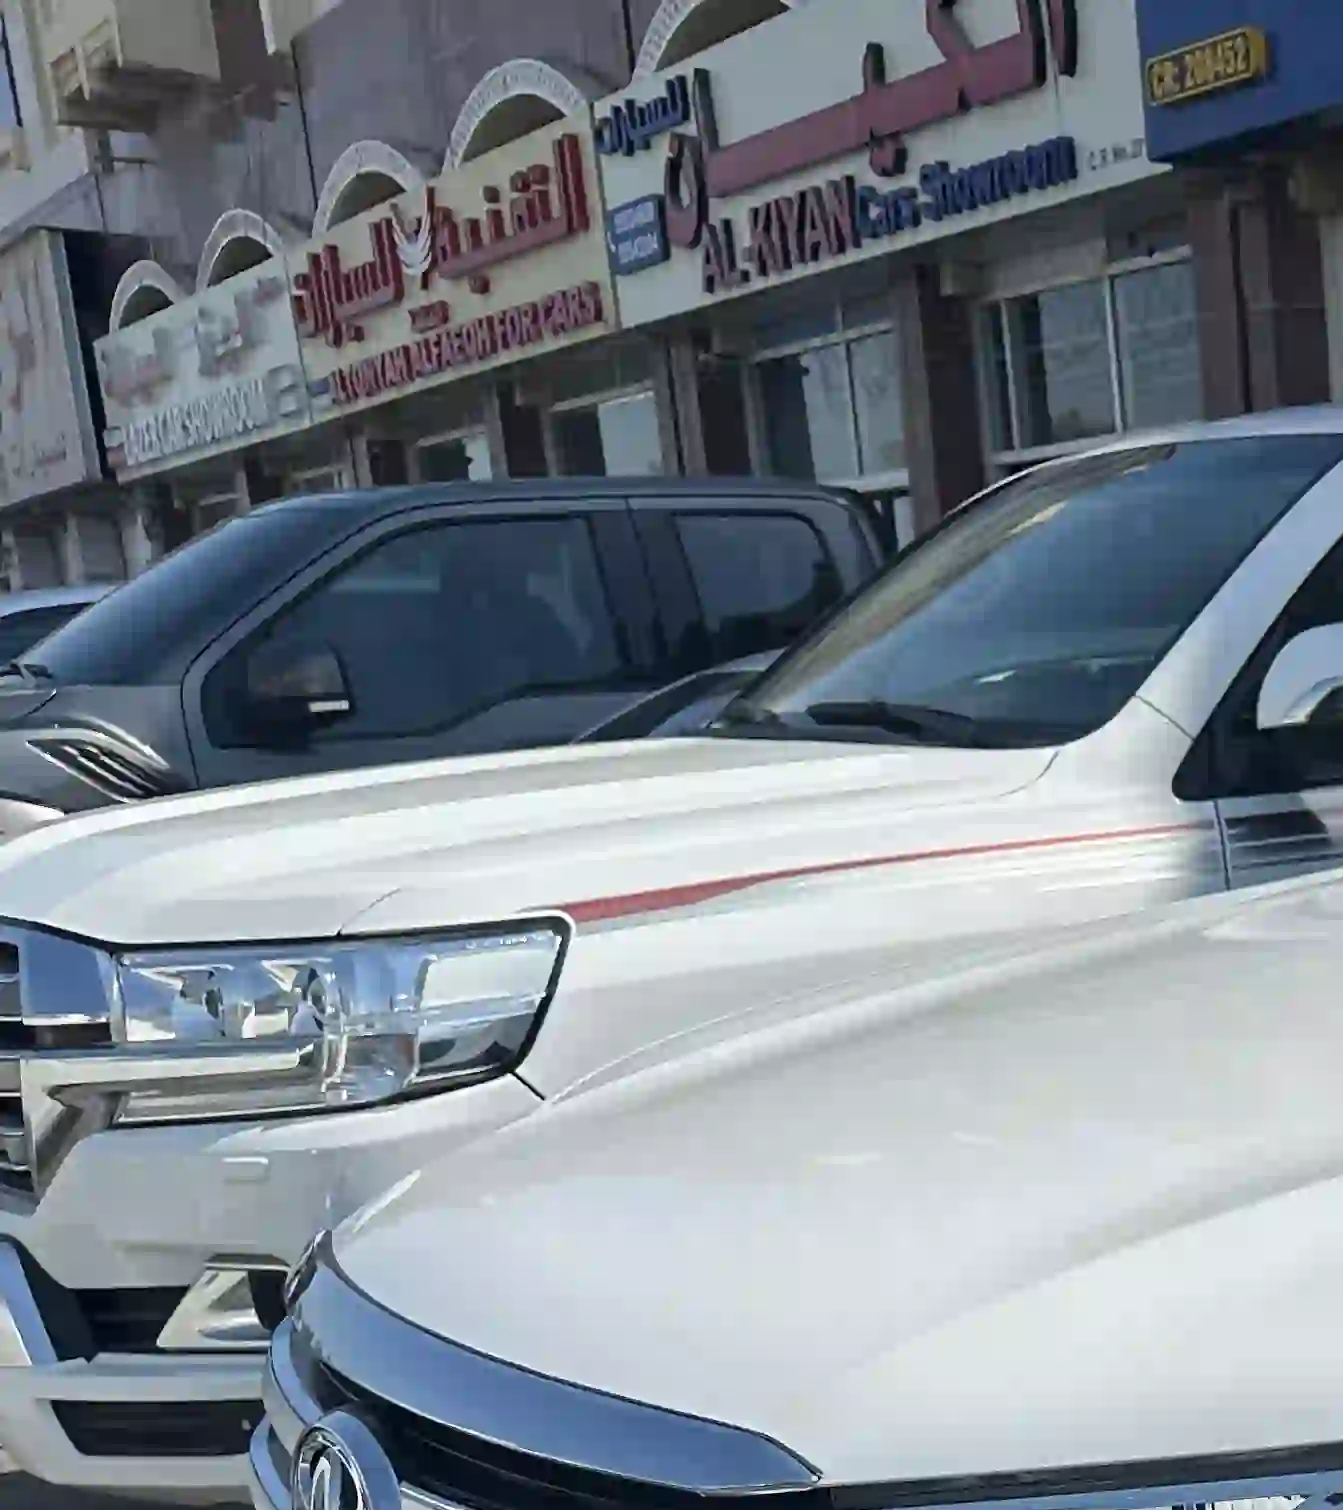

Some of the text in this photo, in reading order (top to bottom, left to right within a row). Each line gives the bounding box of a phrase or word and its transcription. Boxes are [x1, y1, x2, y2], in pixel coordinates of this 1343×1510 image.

[856, 185, 922, 239] Cars
[919, 136, 1079, 222] Showroom
[493, 302, 544, 351] FOR
[539, 280, 604, 338] CARS
